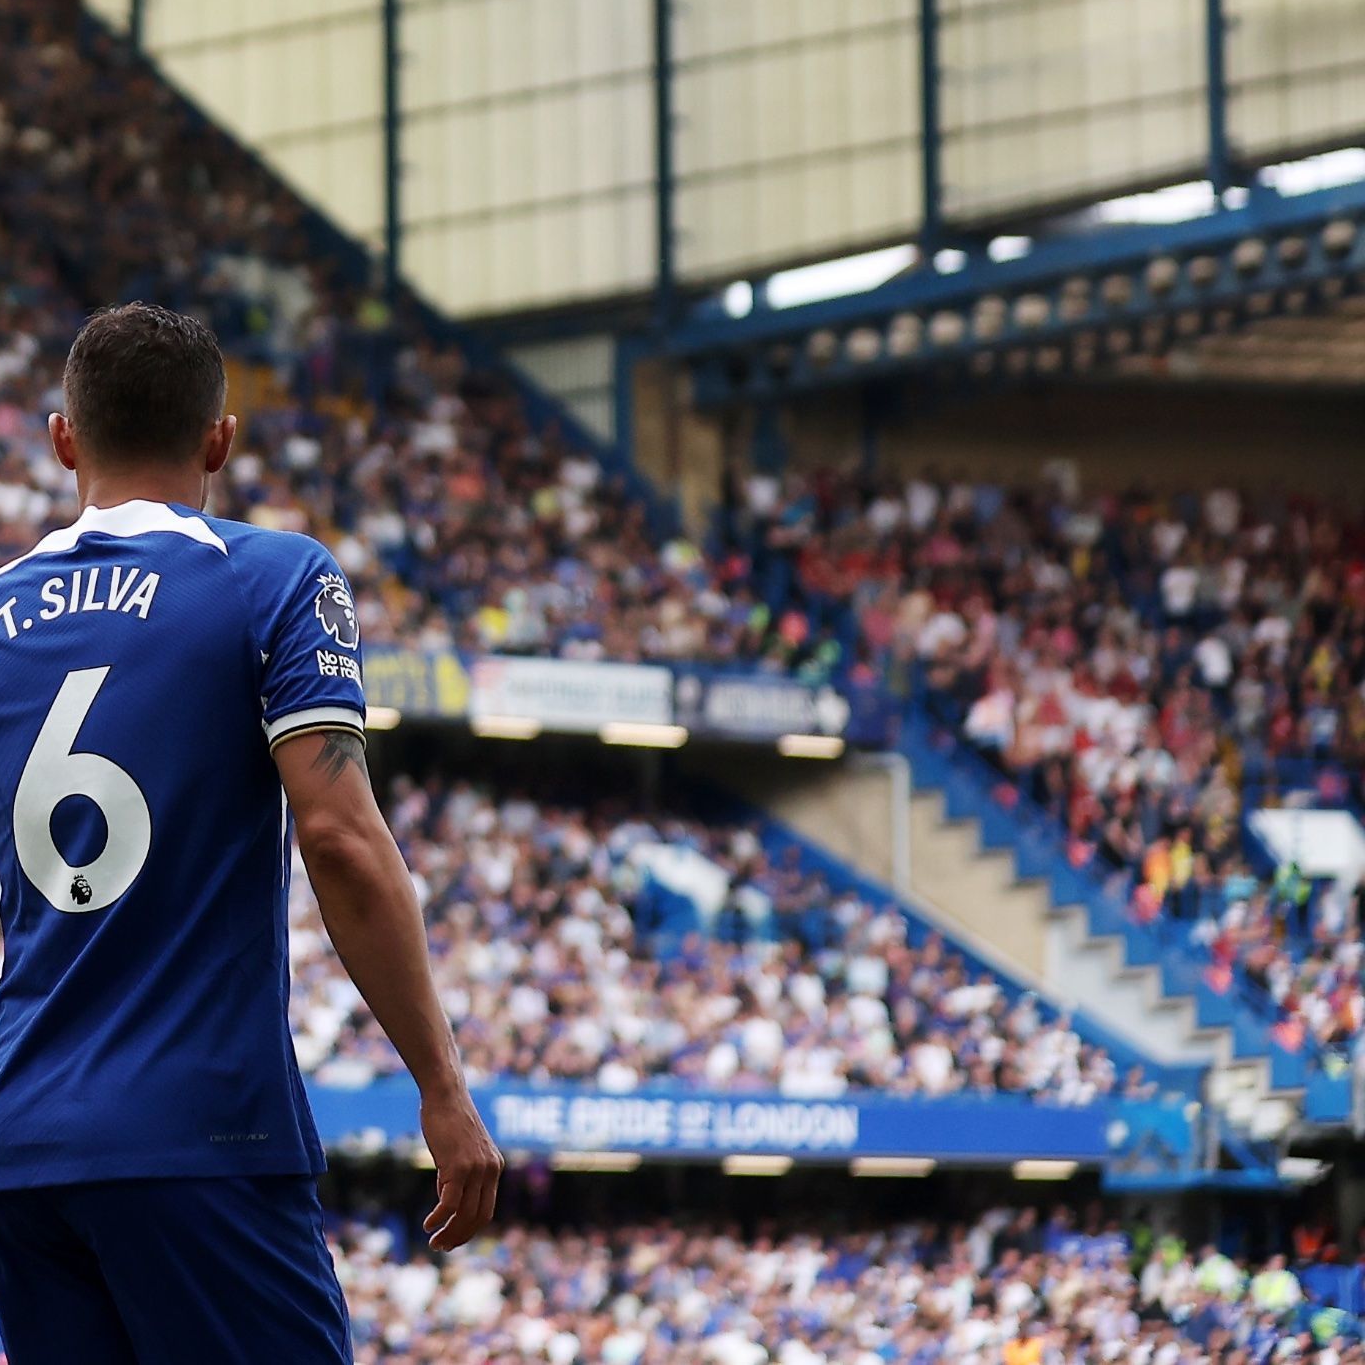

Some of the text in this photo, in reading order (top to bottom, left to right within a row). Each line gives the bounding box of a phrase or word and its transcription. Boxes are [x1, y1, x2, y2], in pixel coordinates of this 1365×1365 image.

[39, 565, 161, 620] SILVA
[316, 649, 338, 665] No
[13, 665, 151, 913] 6
[494, 1094, 566, 1141] THE
[569, 1097, 673, 1146] PRIDE
[714, 1101, 859, 1150] LONDON
